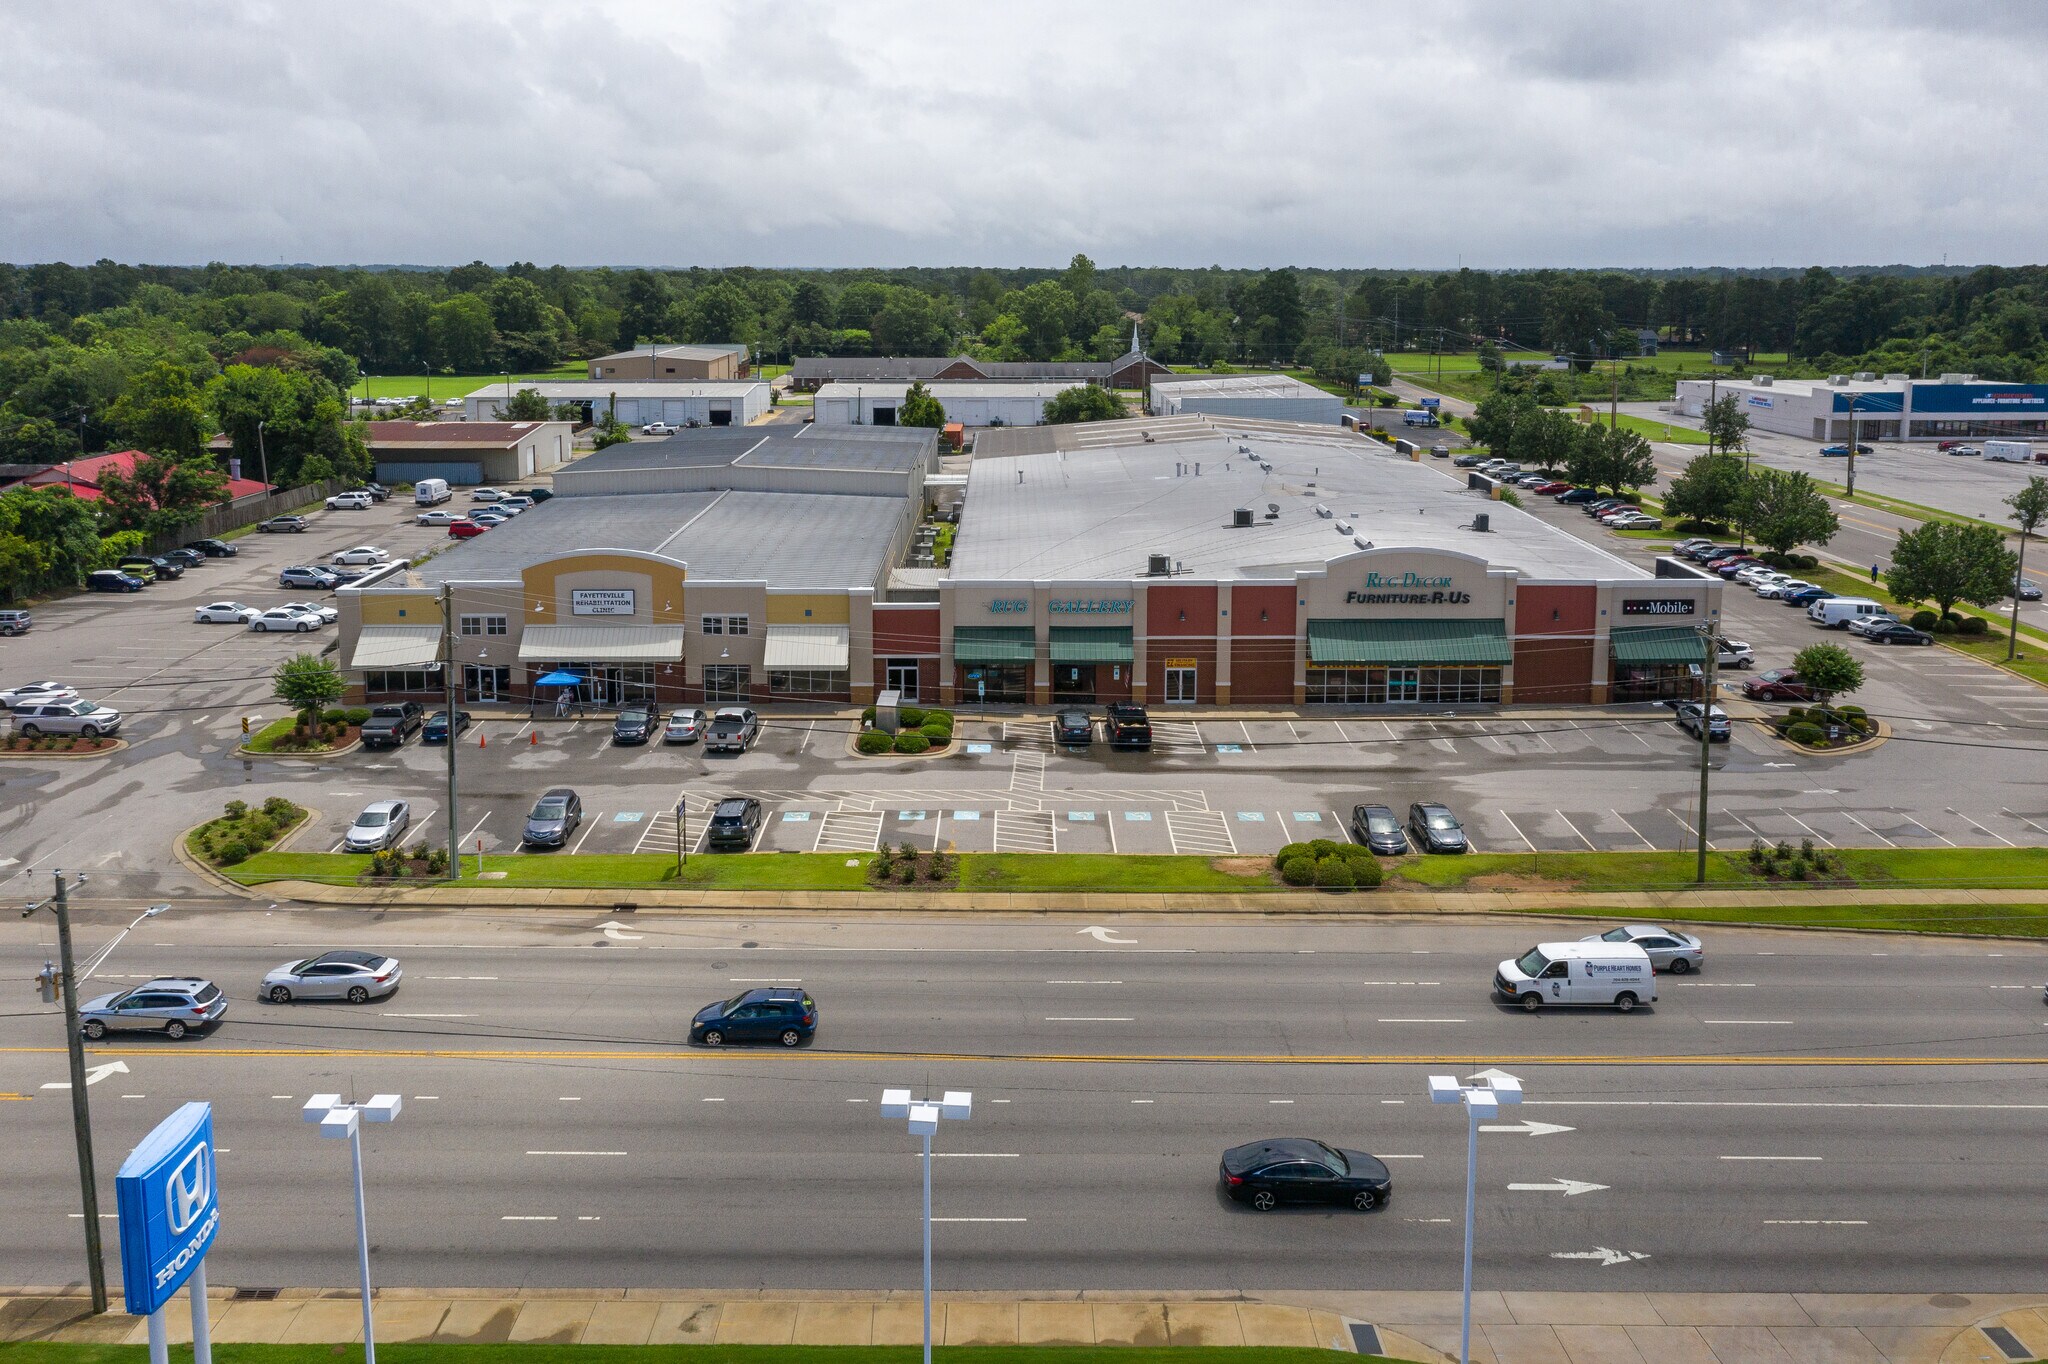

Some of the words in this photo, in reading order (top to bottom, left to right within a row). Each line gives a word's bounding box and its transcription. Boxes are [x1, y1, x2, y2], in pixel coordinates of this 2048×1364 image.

[1366, 571, 1398, 588] RUG
[1402, 571, 1452, 588] DECOR
[990, 599, 1030, 614] RUG
[1047, 599, 1135, 615] GALLERY
[1593, 964, 1610, 972] PURPLE
[1610, 964, 1625, 972] HEART
[1625, 964, 1642, 972] HOMES
[155, 1207, 220, 1290] HONDA
